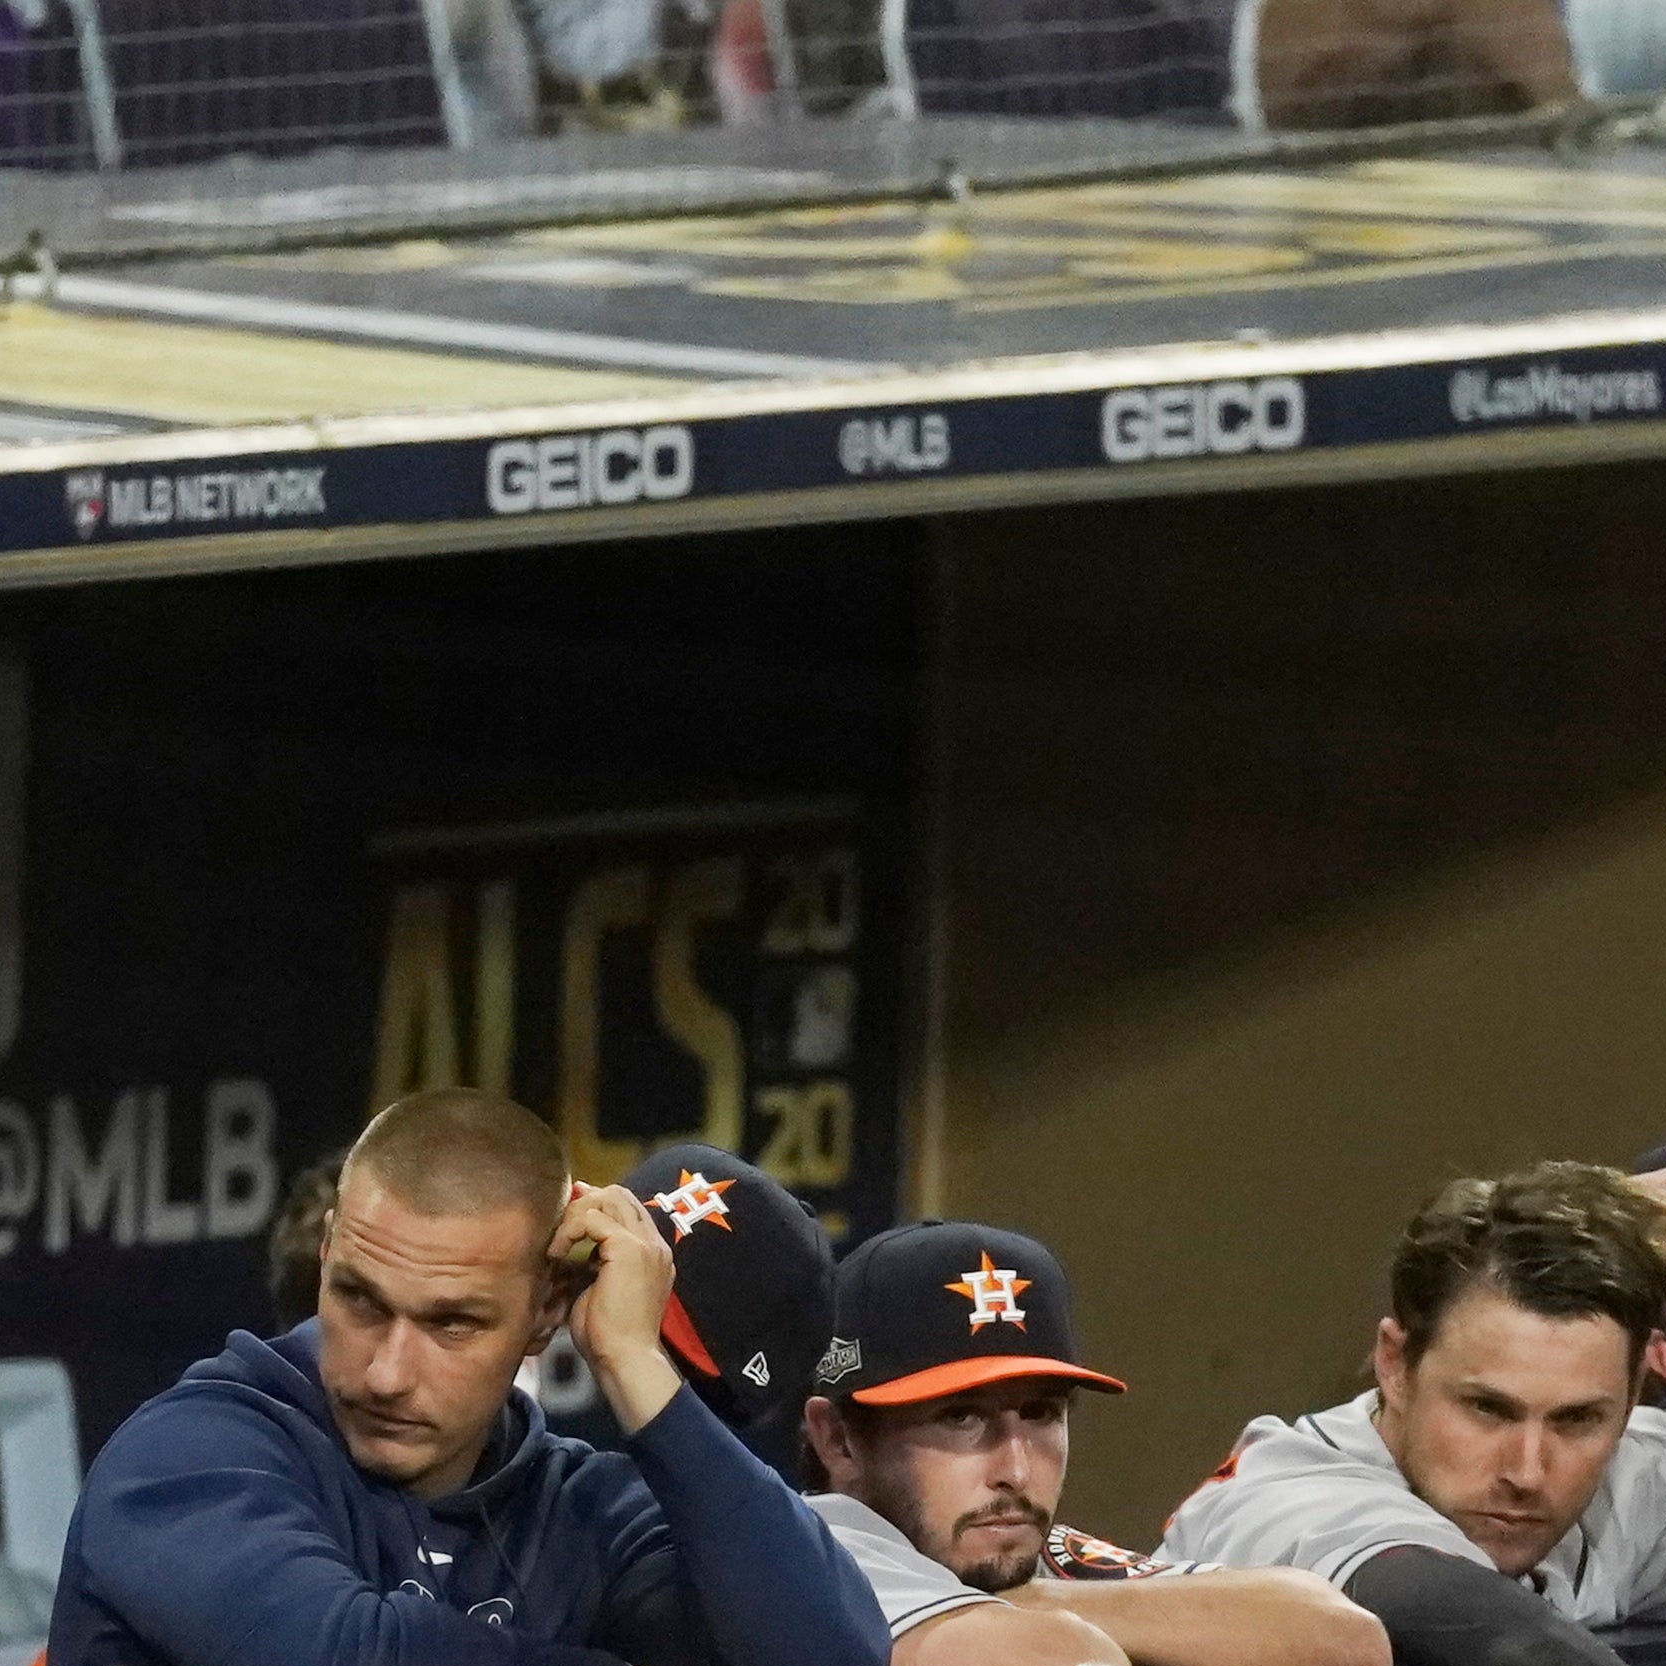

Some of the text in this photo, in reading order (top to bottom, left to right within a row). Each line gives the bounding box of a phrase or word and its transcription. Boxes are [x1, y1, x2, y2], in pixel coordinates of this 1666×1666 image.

[838, 413, 951, 474] @MLB
[1101, 377, 1305, 463] GEICO
[486, 425, 695, 515] GEICO
